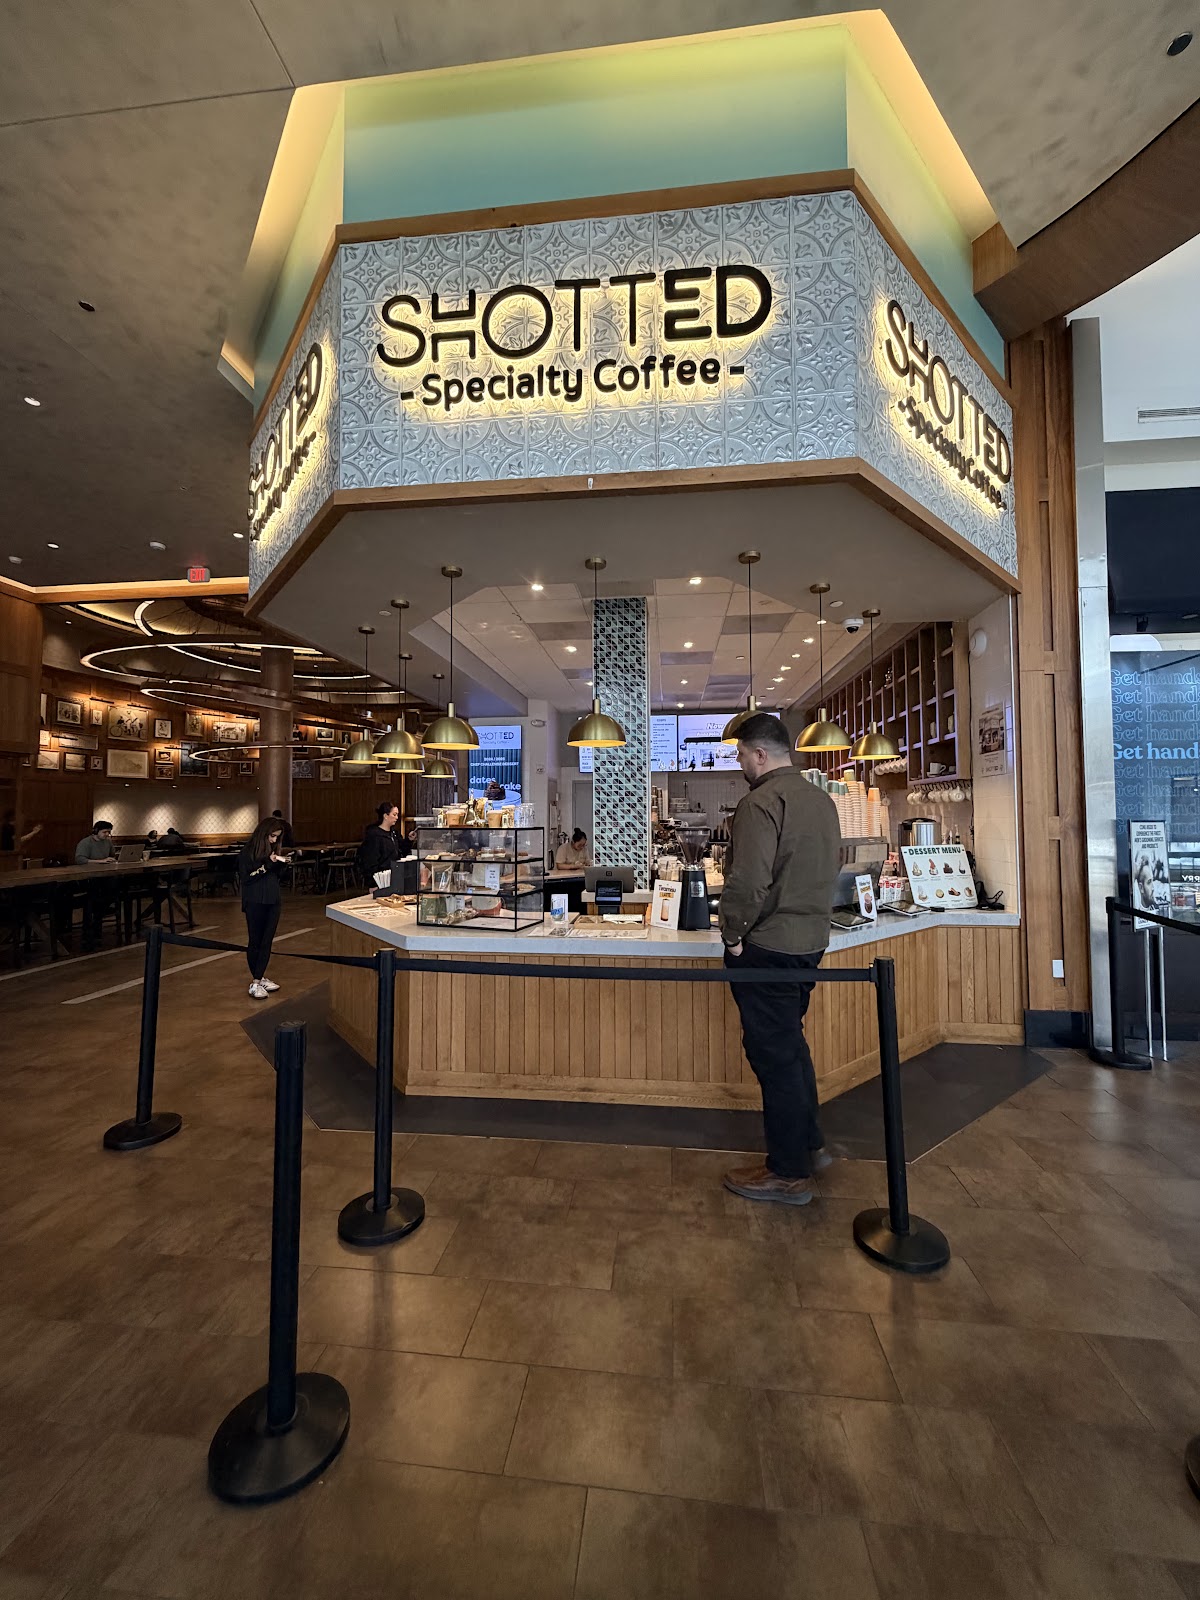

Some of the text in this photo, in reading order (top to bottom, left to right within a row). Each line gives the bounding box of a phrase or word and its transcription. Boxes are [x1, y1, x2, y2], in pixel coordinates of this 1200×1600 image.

[376, 264, 773, 368] SHOTTED
[882, 299, 1012, 485] SHOTTED
[190, 568, 205, 581] EXIT
[1145, 685, 1200, 703] hand
[1146, 704, 1200, 722] hand
[1146, 742, 1200, 760] hand
[469, 775, 496, 784] dates
[908, 847, 940, 855] DESSERT
